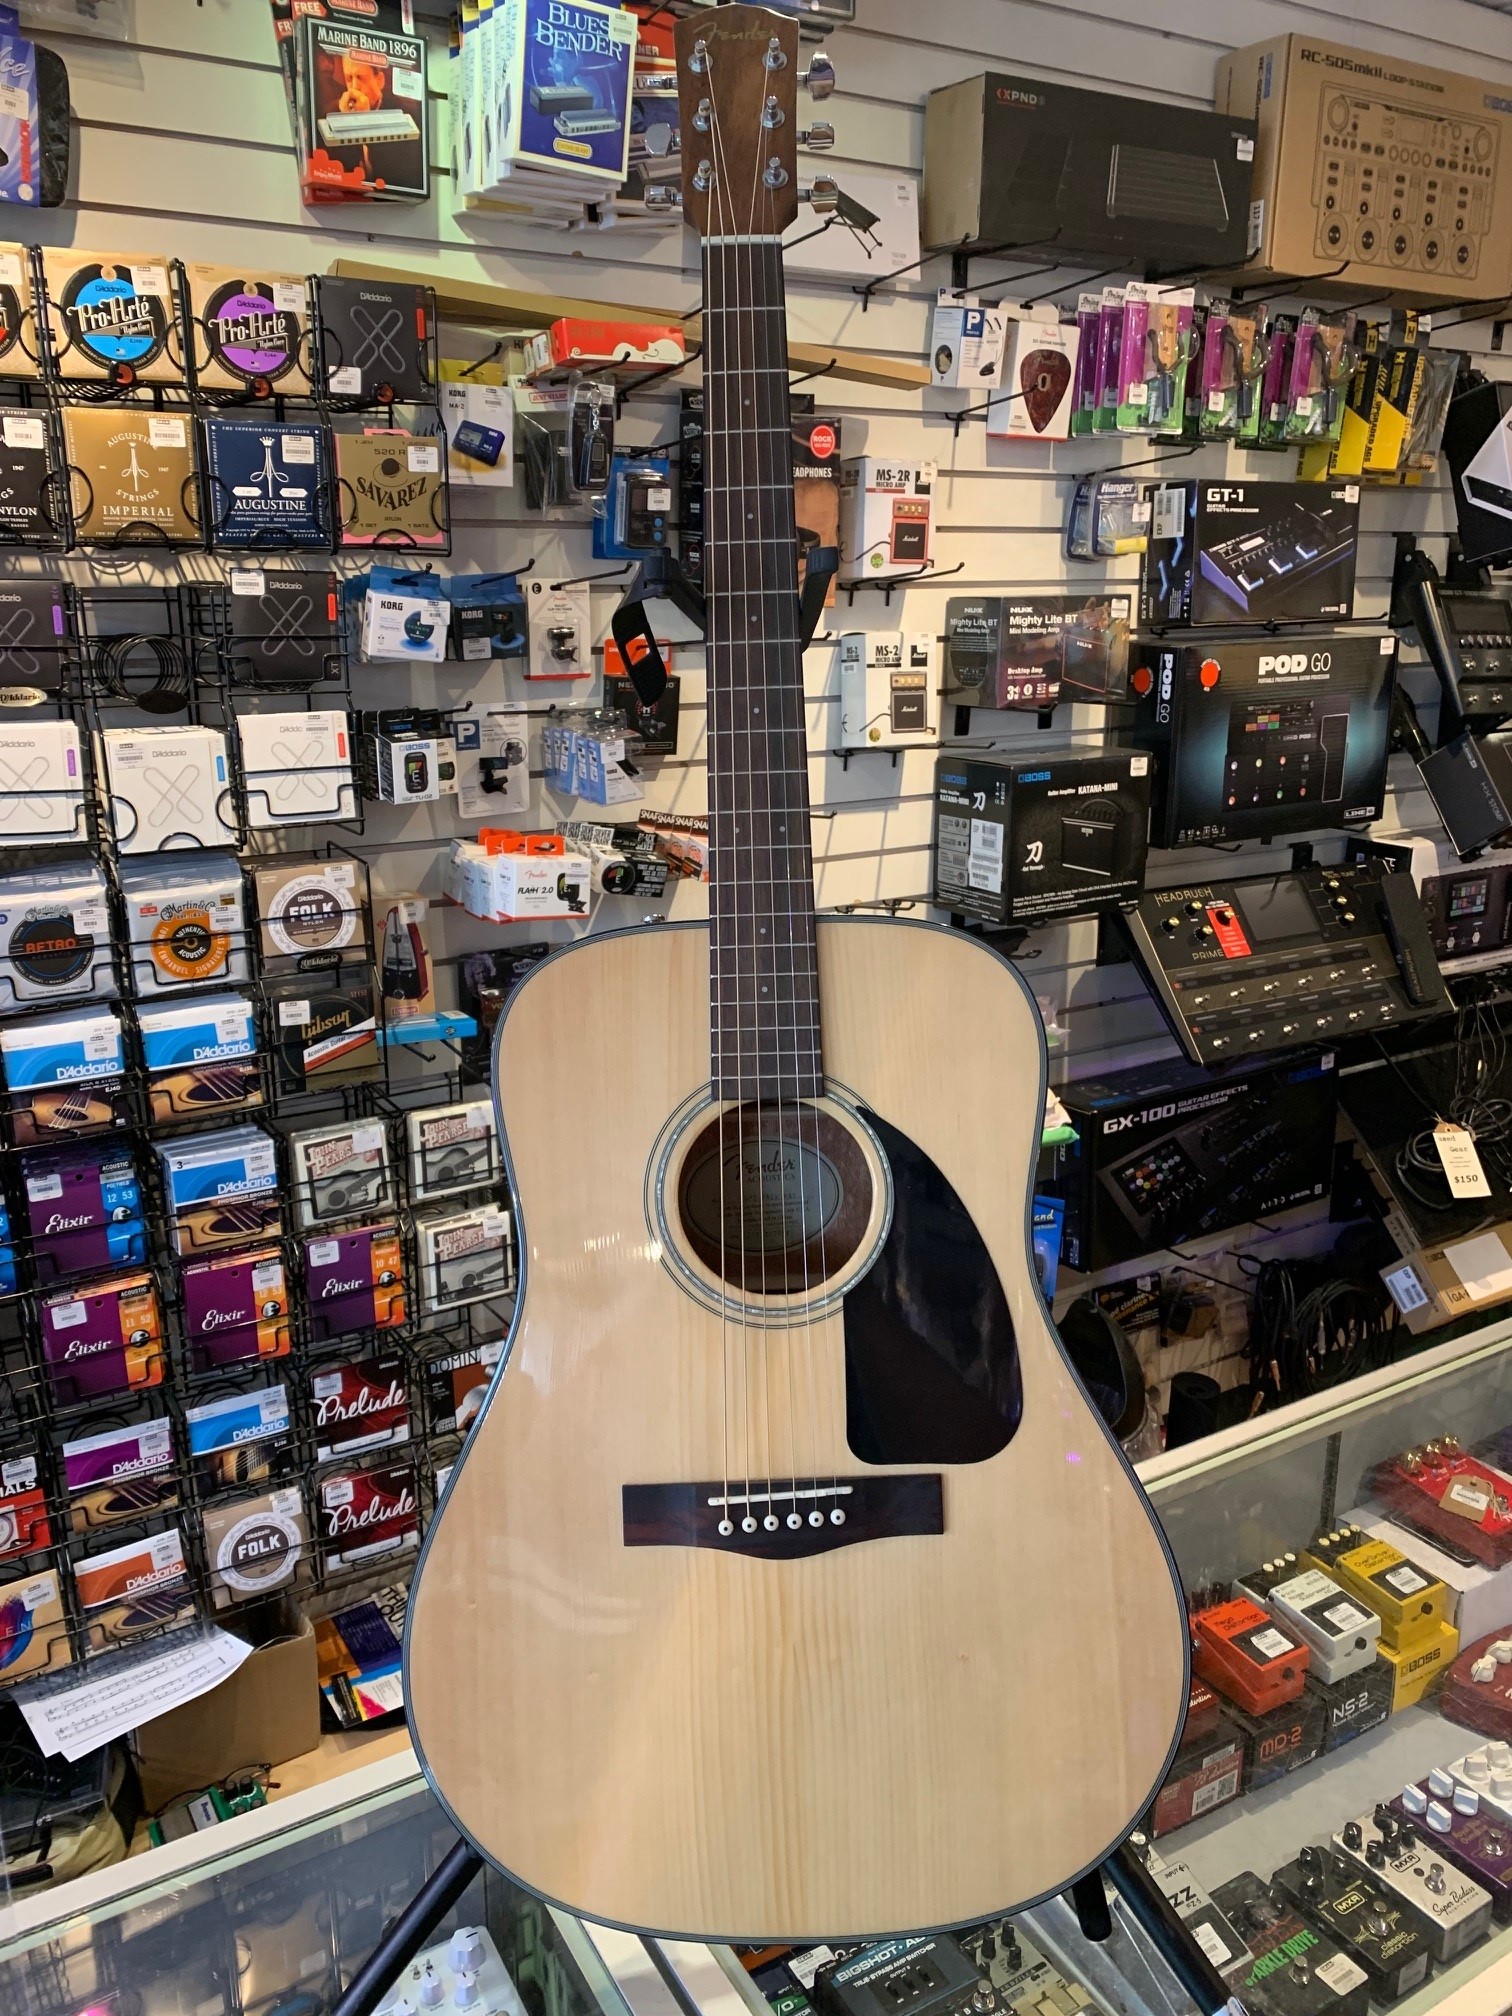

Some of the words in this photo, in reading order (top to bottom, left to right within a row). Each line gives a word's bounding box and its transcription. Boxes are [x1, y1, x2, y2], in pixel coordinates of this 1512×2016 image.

[294, 2, 320, 13] FREE
[548, 2, 610, 36] BLUES
[317, 26, 358, 47] MARINE
[359, 35, 387, 53] BAND
[389, 40, 417, 59] 1896
[536, 18, 622, 61] BENDER
[693, 21, 779, 48] Fender
[813, 435, 833, 443] ROCK
[374, 448, 399, 456] 520
[876, 468, 911, 482] MS-2R
[115, 488, 160, 502] STRINGS
[356, 475, 427, 511] SAVAREZ
[1101, 480, 1134, 494] Hanger
[1206, 488, 1244, 502] GT-1
[102, 505, 175, 517] IMPERIAL
[234, 499, 307, 511] AUGUSTINE
[380, 600, 403, 611] KORG
[461, 609, 483, 619] KORG
[1009, 614, 1042, 628] Mighty
[1044, 613, 1063, 625] Lite
[1065, 614, 1078, 624] BT
[875, 645, 899, 657] MS-2
[1258, 654, 1308, 675] POD
[1311, 652, 1332, 672] GO
[1161, 653, 1174, 700] POD
[1160, 703, 1170, 723] GO
[1020, 771, 1051, 783] BOSS
[541, 885, 554, 894] 2.0
[1154, 886, 1214, 907] HEADRUSH
[289, 902, 335, 922] FOLK
[178, 945, 206, 959] ACOUSTIC
[1192, 950, 1224, 960] PRIME
[158, 950, 190, 975] EMMANUEL
[193, 1041, 251, 1061] D'Addario
[307, 1043, 330, 1059] Acoustic
[330, 1035, 347, 1050] Guitar
[57, 1060, 118, 1080] D'Addario
[1103, 1103, 1176, 1135] GX-100
[1178, 1094, 1209, 1108] GUITAR
[1209, 1084, 1248, 1101] EFFECTS
[1177, 1096, 1229, 1114] PROCESSOR
[102, 1161, 129, 1172] ACOUSTIC
[176, 1160, 184, 1170] 3
[723, 1150, 795, 1181] Fender
[217, 1176, 272, 1195] D'Addario
[1454, 1174, 1479, 1184] $150
[107, 1194, 117, 1203] 12
[122, 1190, 133, 1200] 53
[249, 1189, 273, 1199] BRONZE
[45, 1213, 94, 1234] Elixir
[372, 1229, 396, 1239] ACOUSTIC
[375, 1259, 385, 1268] 10
[388, 1255, 398, 1265] 47
[120, 1286, 147, 1297] ACOUSTIC
[321, 1278, 364, 1299] Elixir
[125, 1318, 135, 1328] 11
[140, 1315, 151, 1324] 52
[202, 1309, 247, 1331] Elixir
[65, 1340, 112, 1362] Elixir
[308, 1380, 406, 1427] Prelude
[233, 1419, 285, 1443] D'Addario
[113, 1452, 169, 1475] D'Addario
[146, 1465, 169, 1476] BRONZE
[322, 1487, 416, 1536] Prelude
[238, 1534, 281, 1560] FOLK
[126, 1563, 182, 1591] D'Addario
[1404, 1647, 1441, 1675] BOSS
[1333, 1691, 1369, 1723] NS-2
[1260, 1725, 1303, 1760] MD-2
[1394, 1853, 1417, 1870] MXR
[1164, 1868, 1180, 1880] INPUT
[1336, 1893, 1364, 1913] MXR
[1432, 1901, 1455, 1917] Super
[1449, 1886, 1476, 1904] Badass
[1280, 1928, 1320, 1957] DRIVE
[1381, 1931, 1409, 1951] classic
[1381, 1931, 1420, 1960] distortion
[852, 1963, 894, 1988] TRUE-BYPASS
[894, 1957, 908, 1969] AMP
[906, 1943, 937, 1962] SWITCHER
